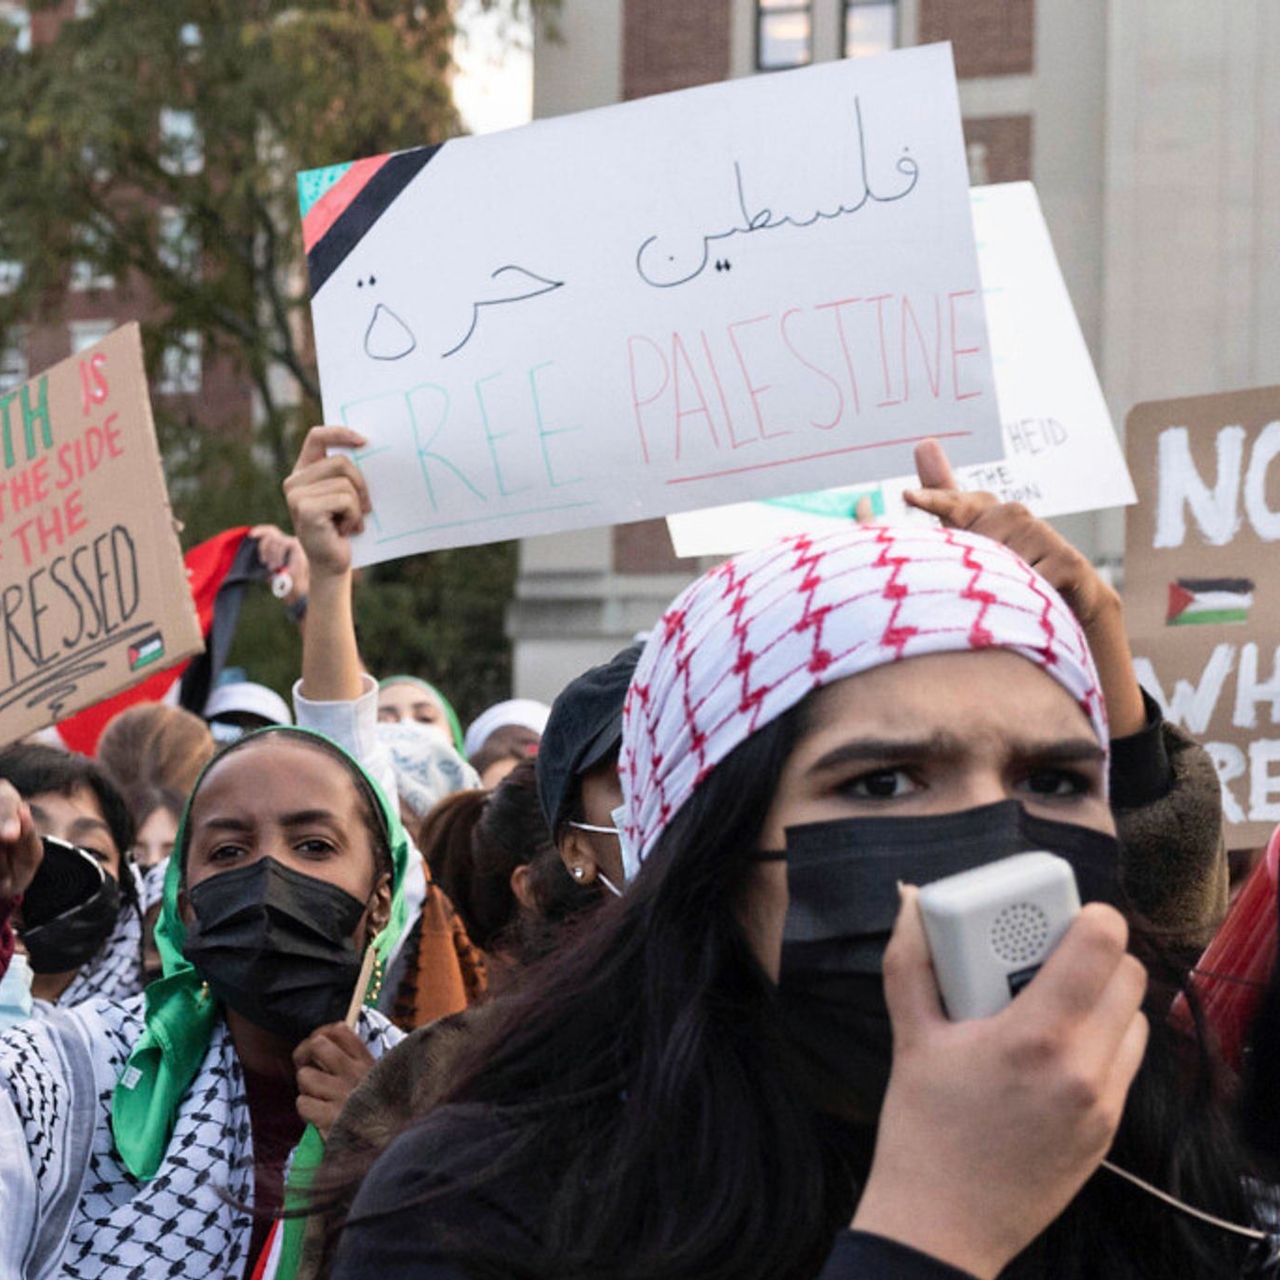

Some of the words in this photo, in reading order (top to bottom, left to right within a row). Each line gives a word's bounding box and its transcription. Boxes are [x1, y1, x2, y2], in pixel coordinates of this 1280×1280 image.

[635, 95, 920, 289] فلسطين
[357, 263, 566, 362] حرة
[79, 353, 110, 417] IS
[341, 361, 587, 532] FREE
[626, 290, 986, 466] PALESTINE
[54, 412, 125, 492] SIDE
[11, 489, 89, 567] THE
